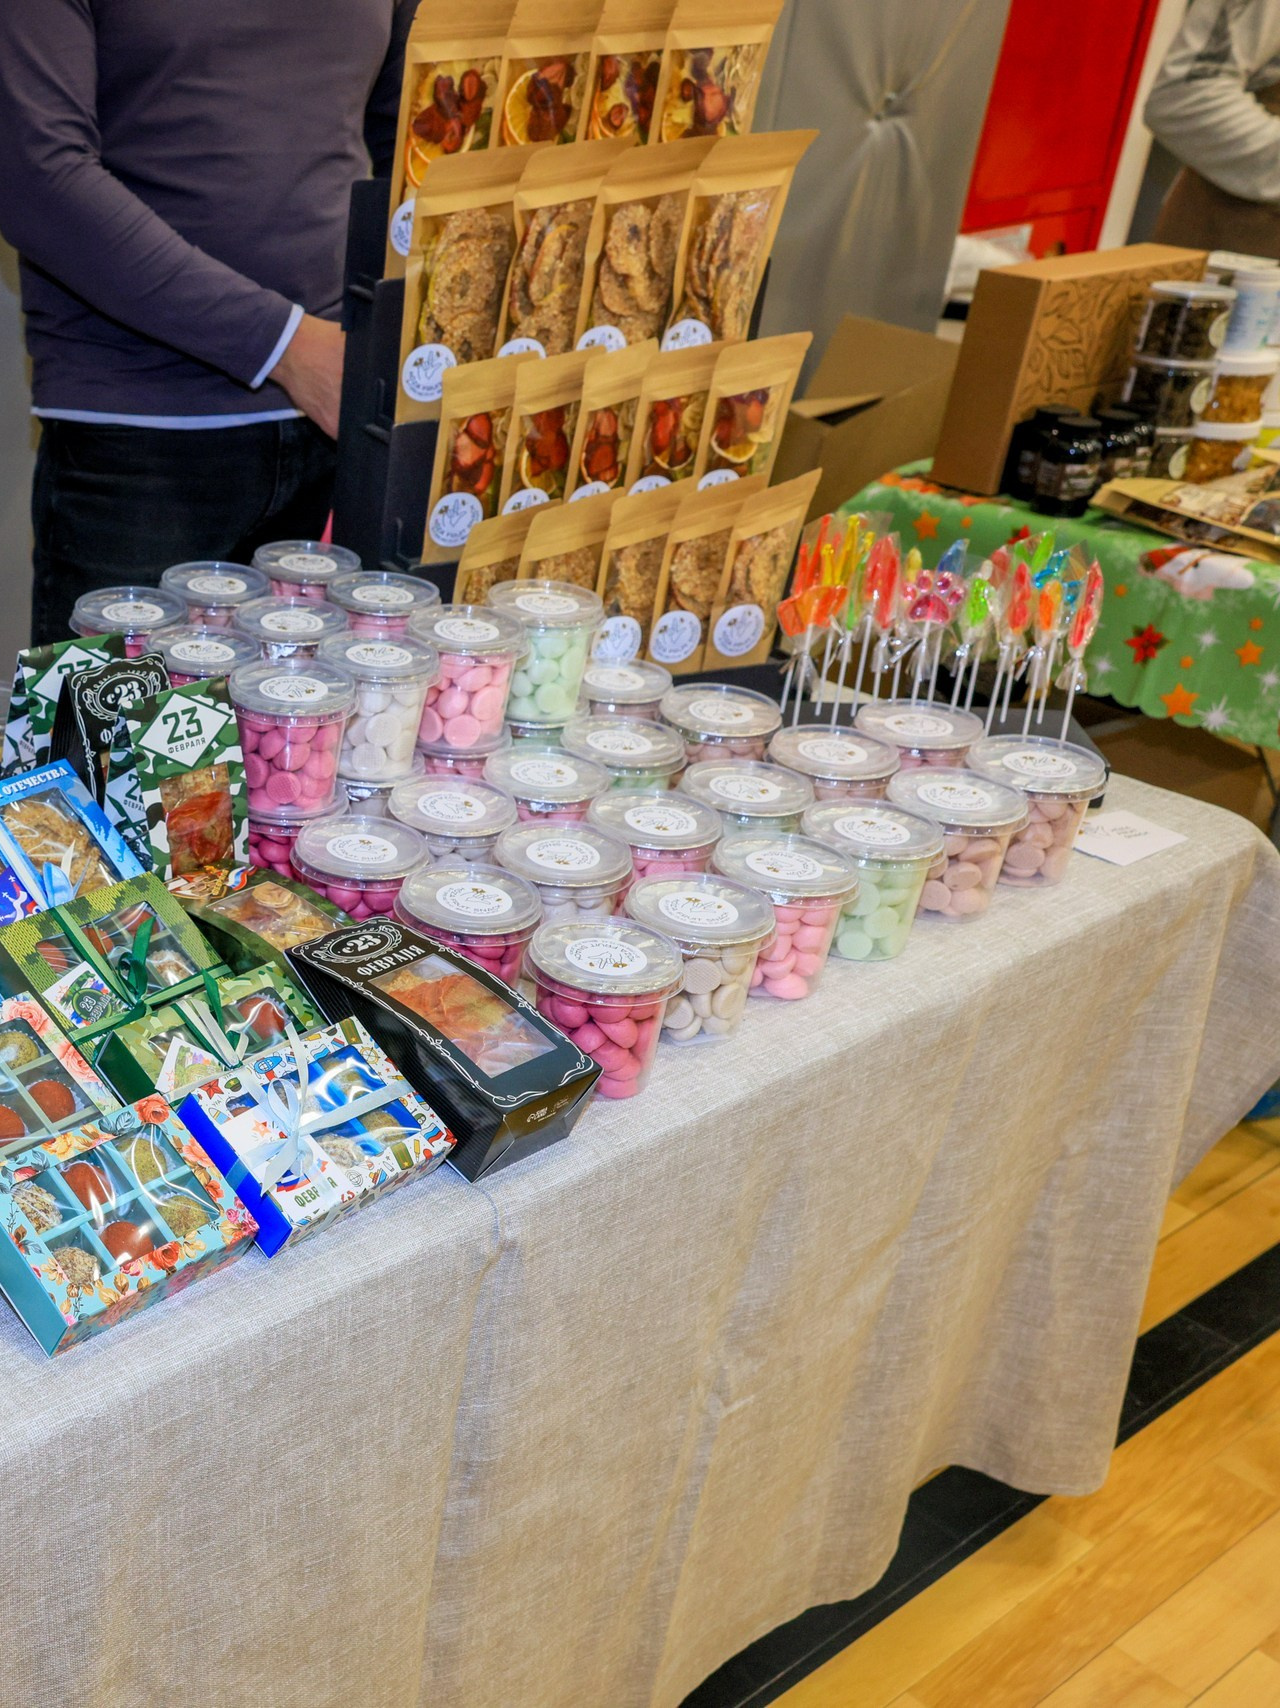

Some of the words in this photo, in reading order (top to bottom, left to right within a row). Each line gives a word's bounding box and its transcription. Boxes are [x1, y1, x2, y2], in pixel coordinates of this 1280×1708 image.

[162, 706, 204, 745] 23
[167, 737, 207, 755] ФЕВРАЛЯ
[2, 767, 69, 796] ОТЕЧЕСТВА
[357, 944, 426, 976] ФЕВРАЛЯ
[79, 996, 97, 1013] 23
[294, 1176, 339, 1208] ФЕВРЯ
